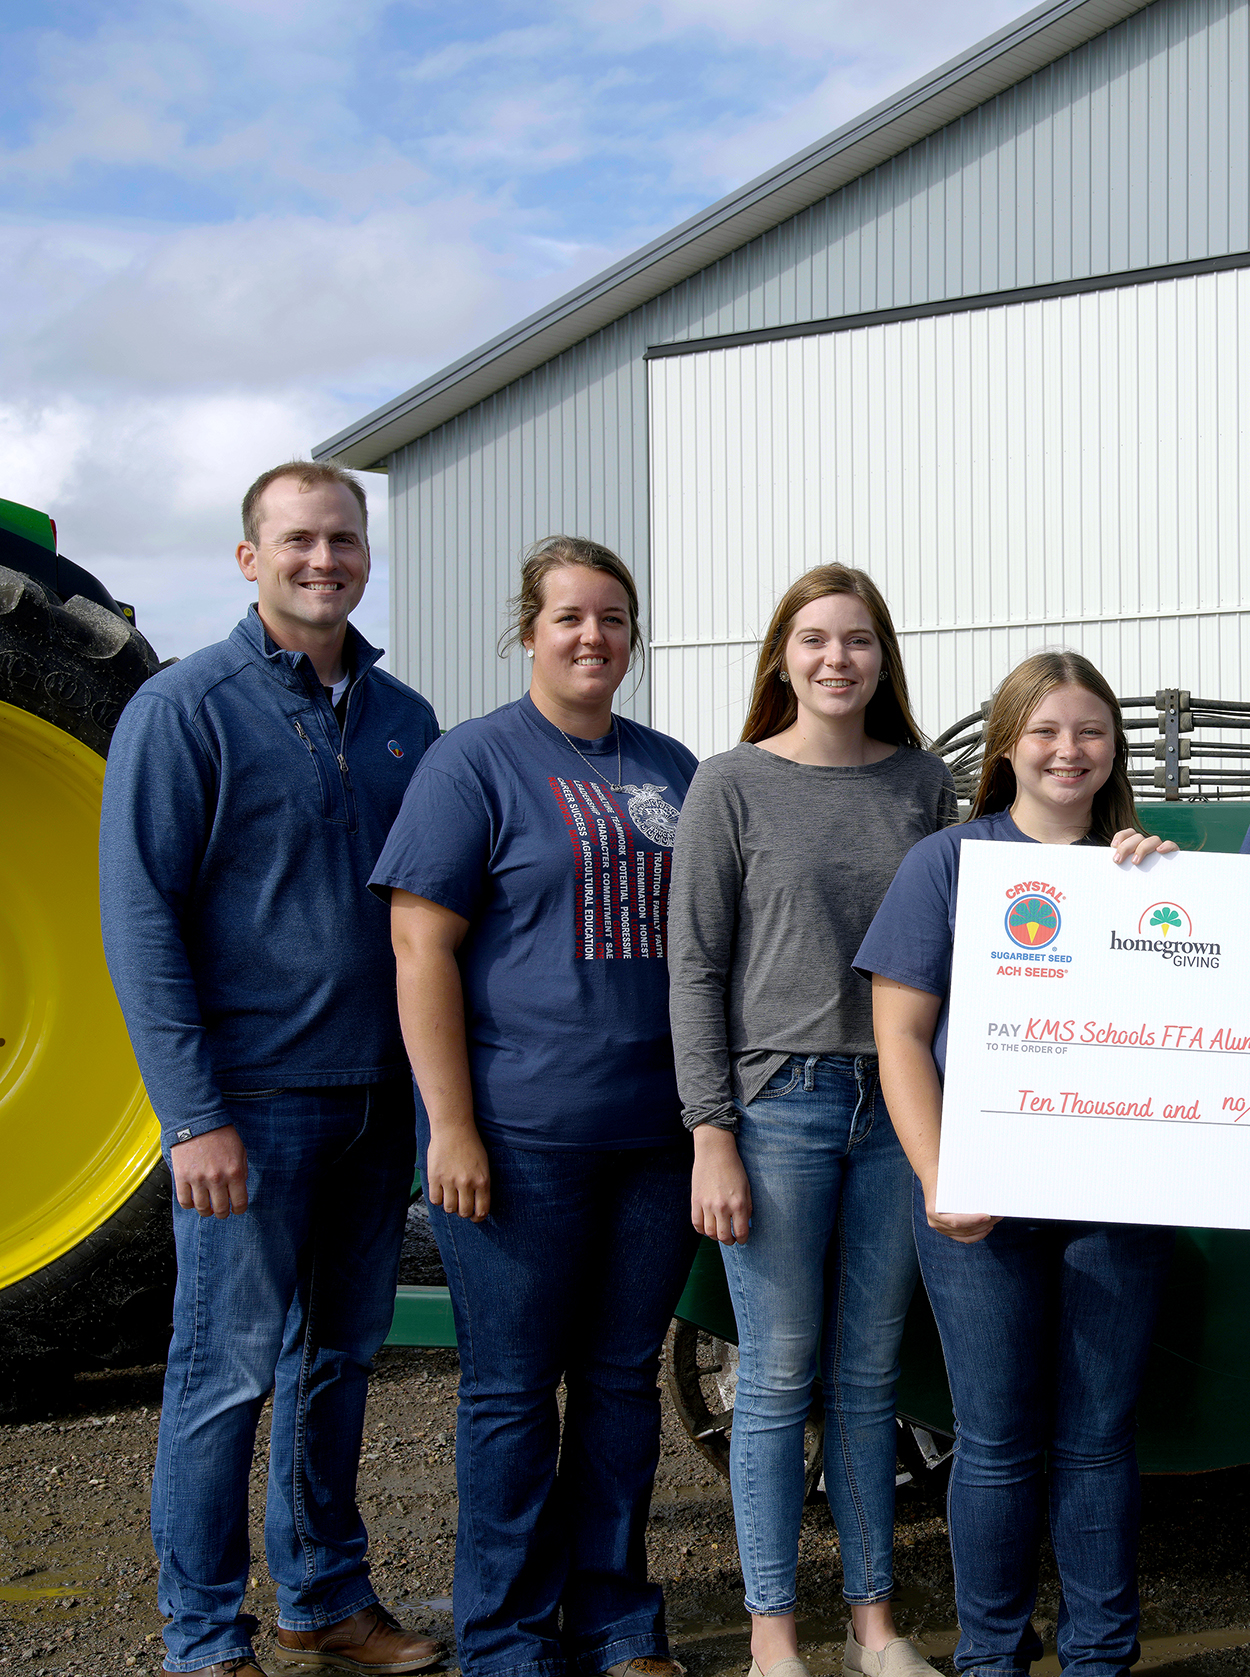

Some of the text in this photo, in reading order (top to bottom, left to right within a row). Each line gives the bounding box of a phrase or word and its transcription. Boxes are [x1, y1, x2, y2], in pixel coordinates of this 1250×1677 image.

[580, 804, 598, 846] LEADERSHIP
[603, 814, 617, 850] SUCCESS
[610, 816, 626, 856] TEAMWORK
[622, 822, 636, 874] COMMUNITY
[548, 777, 584, 958] KERKHOVEN MURDOCK SUNBURG FFA
[557, 777, 594, 960] CAREER SUCCESS AGRICULTURAL EDUCATION
[573, 780, 614, 960] LEADERSHIP CHARACTER COMMITMENT SAE
[594, 852, 602, 896] PERSONAL
[610, 854, 620, 916] OPPORTUNITY
[619, 860, 628, 902] POTENTIAL
[646, 852, 654, 892] FOREVER
[653, 852, 662, 896] TRADITION
[629, 876, 638, 913] SERVICE
[636, 852, 649, 958] DETERMINATION HONEST
[1006, 881, 1063, 904] CRYSTAL
[595, 900, 604, 938] GROWTH
[620, 906, 632, 959] PROGRESSIVE
[596, 942, 604, 959] CDE
[612, 920, 622, 958] GROWTH
[631, 920, 640, 958] LOYALTY
[648, 923, 656, 958] FUTURE
[655, 934, 664, 958] FAITH
[991, 951, 1072, 963] SUGARBEET SEED
[1110, 930, 1221, 959] homegrown
[997, 966, 1064, 978] ACH SEEDS
[1173, 955, 1220, 969] GIVING
[988, 1023, 1020, 1037] PAY
[1025, 1018, 1075, 1041] KMS
[1080, 1021, 1155, 1045] Schools
[1161, 1025, 1204, 1049] FFA
[1000, 1044, 1018, 1052] THE
[1020, 1045, 1052, 1054] ORDER
[1018, 1090, 1055, 1112] Ten
[1060, 1092, 1154, 1117] Thousand
[1163, 1100, 1201, 1120] and
